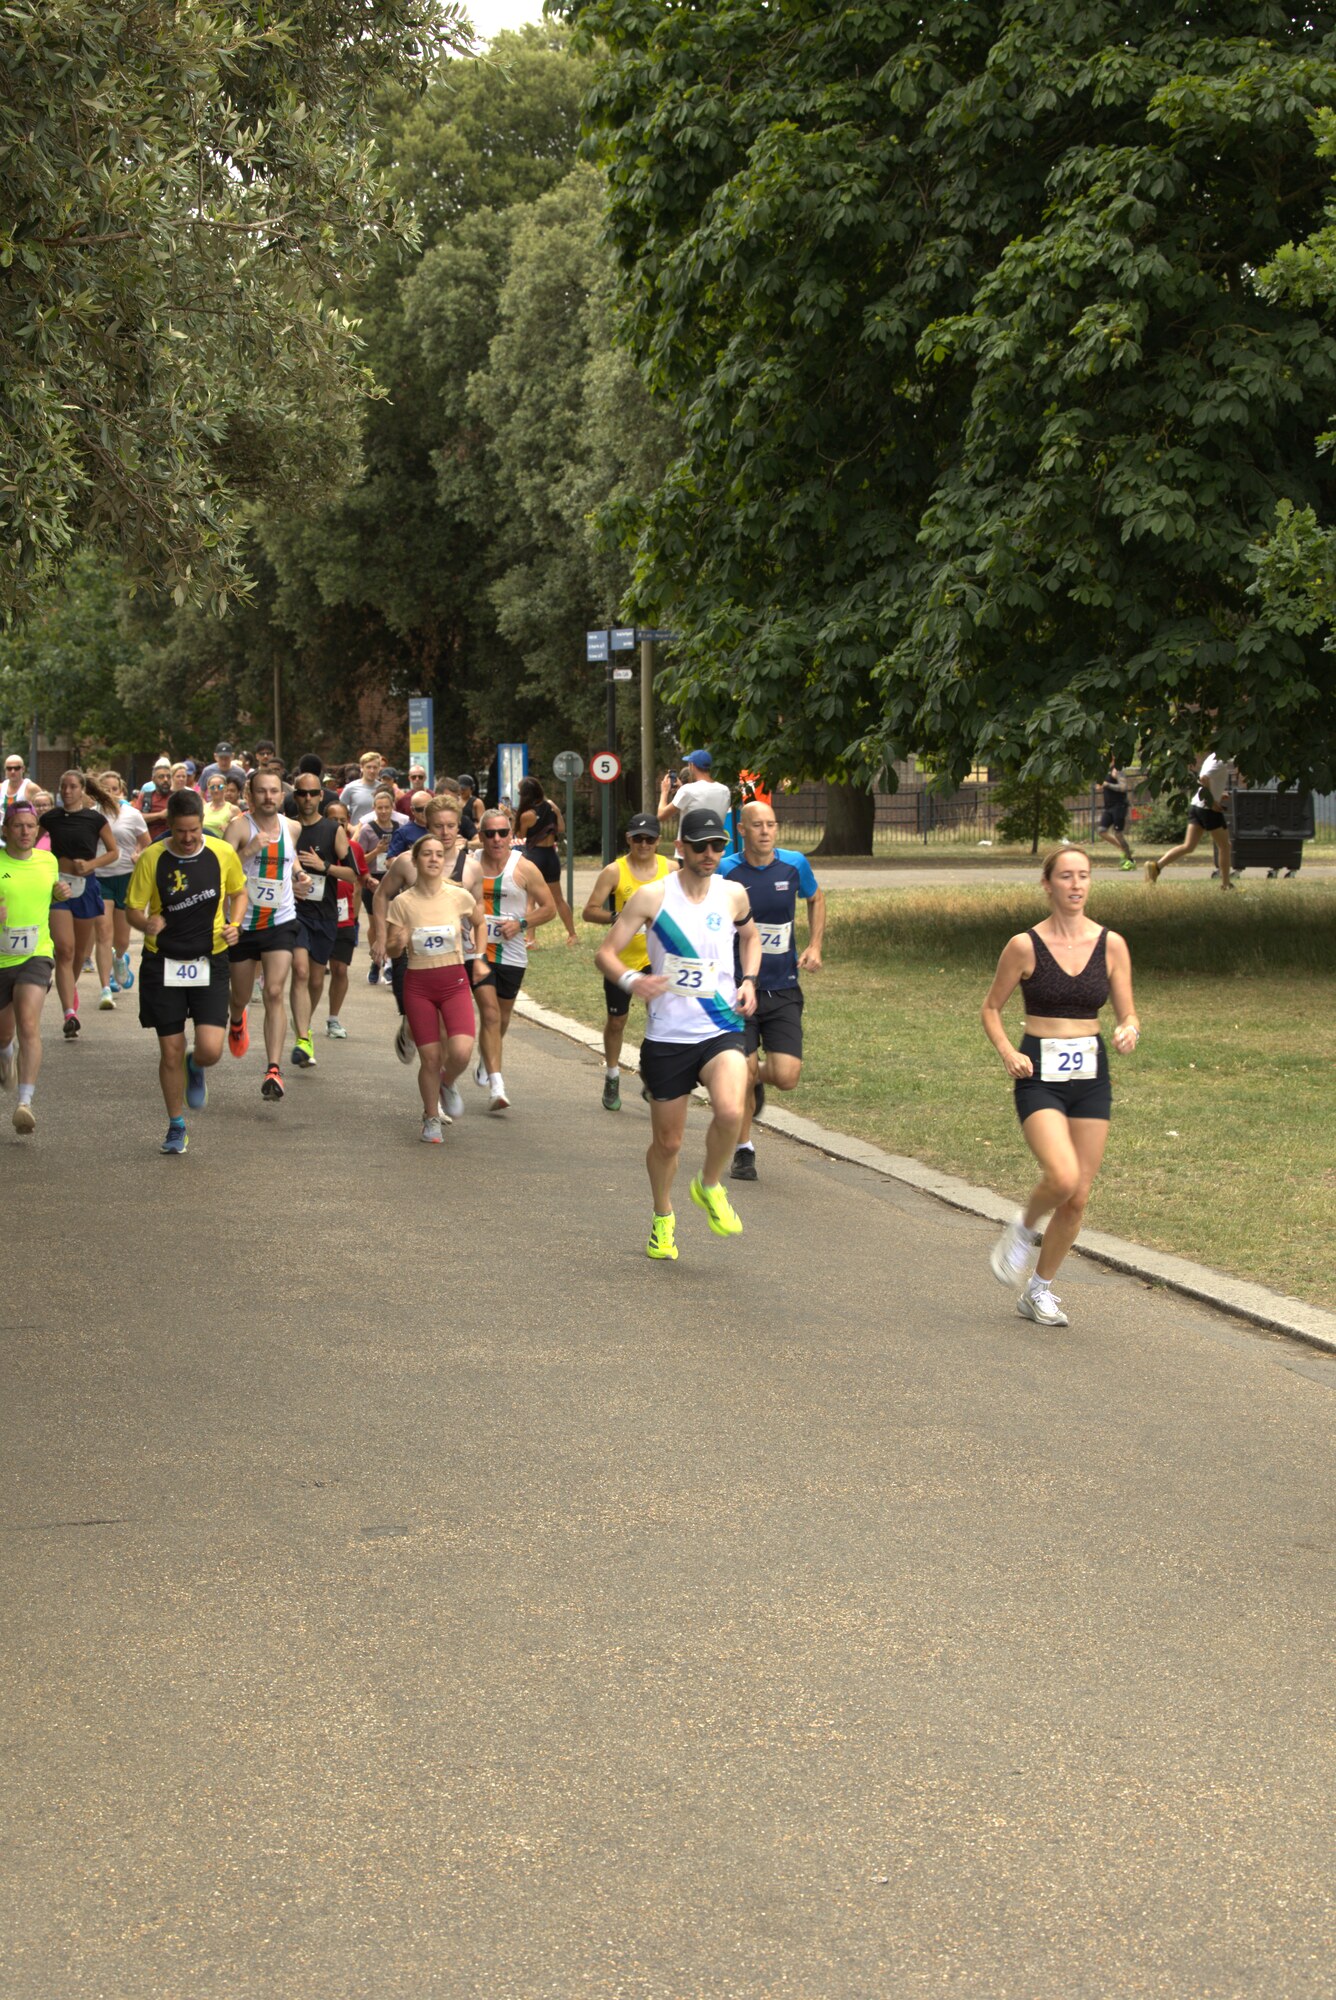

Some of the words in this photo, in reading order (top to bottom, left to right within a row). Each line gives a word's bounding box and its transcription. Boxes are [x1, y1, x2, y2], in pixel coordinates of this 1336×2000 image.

[601, 761, 610, 773] 5
[256, 886, 275, 901] 75
[487, 923, 502, 937] 16
[10, 935, 28, 949] 71
[424, 935, 444, 949] 49
[761, 932, 781, 947] 74
[176, 964, 198, 979] 40
[676, 969, 703, 989] 23
[1058, 1051, 1083, 1071] 29
